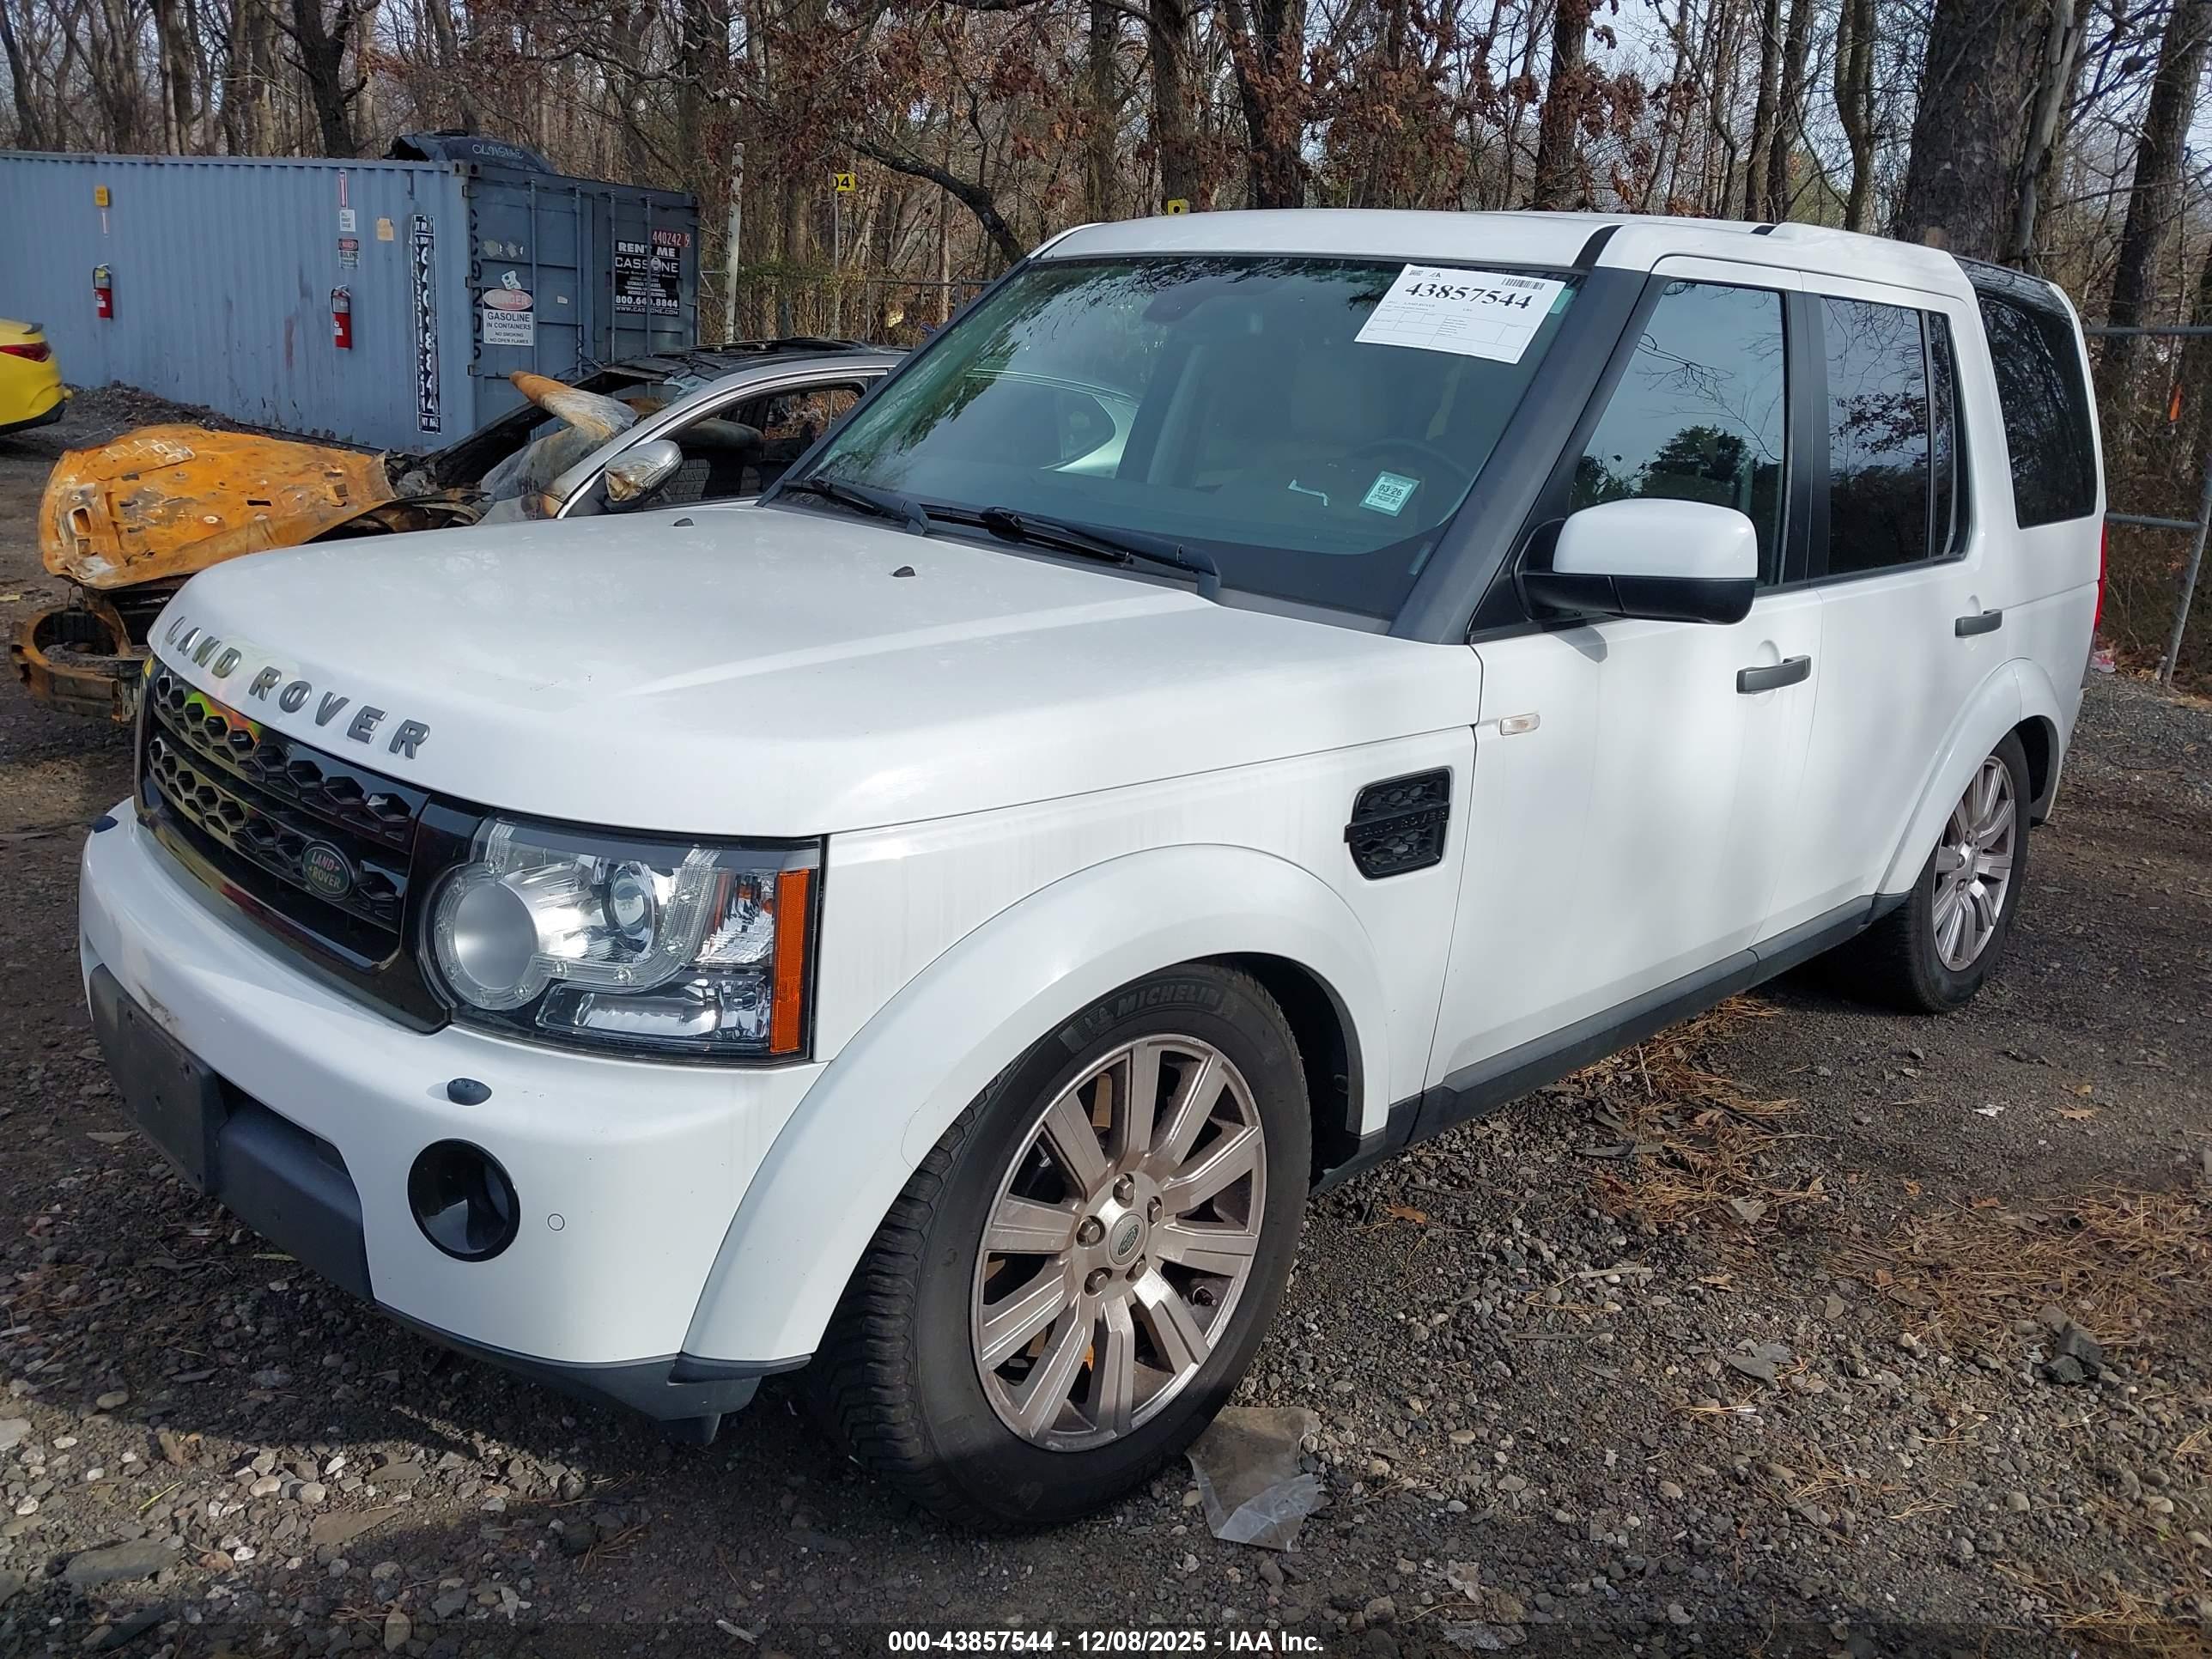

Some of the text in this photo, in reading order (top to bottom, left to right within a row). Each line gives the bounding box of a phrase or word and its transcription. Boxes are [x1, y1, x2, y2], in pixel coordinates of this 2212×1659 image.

[653, 230, 682, 246] 440242
[618, 241, 676, 257] REN ME
[1405, 282, 1533, 310] 43857544
[487, 311, 531, 323] GASOLINE
[616, 306, 678, 315] WWW.CASONE.COM
[494, 322, 532, 331] CONTAINERS
[165, 616, 430, 760] LAND ROVER
[1116, 984, 1221, 1018] MICHELIN
